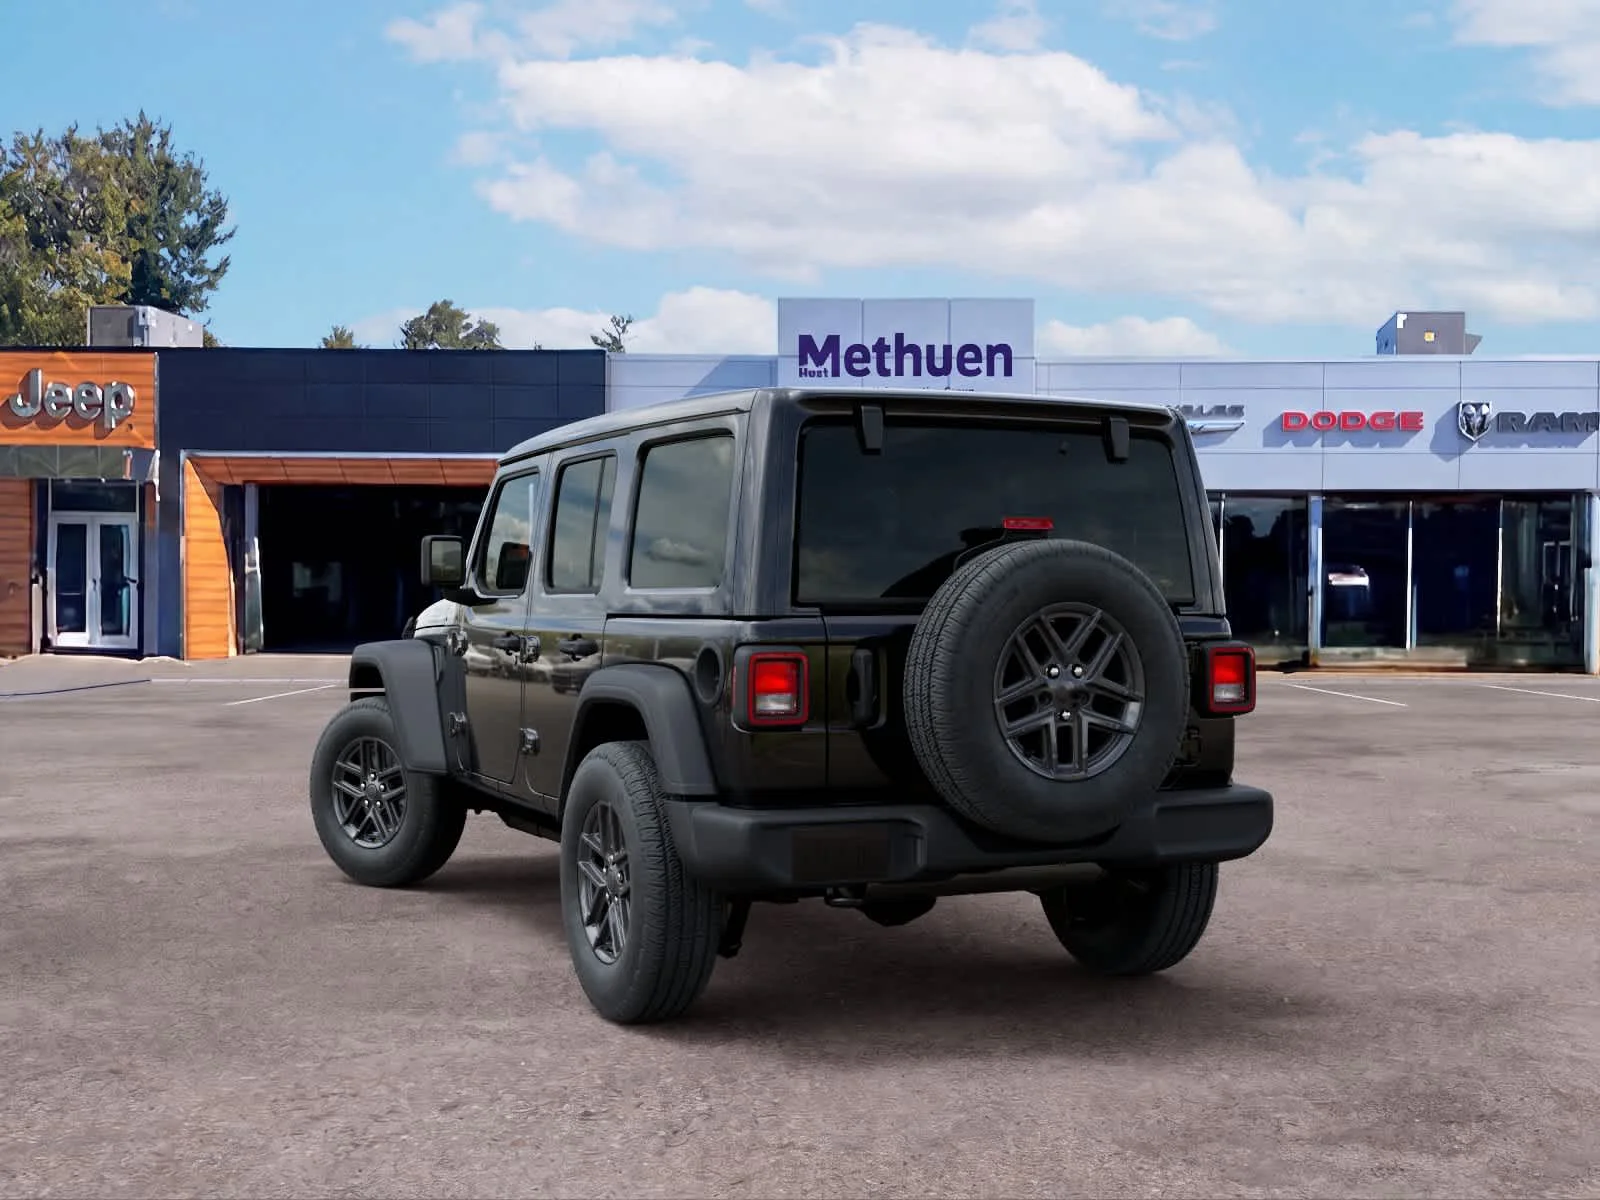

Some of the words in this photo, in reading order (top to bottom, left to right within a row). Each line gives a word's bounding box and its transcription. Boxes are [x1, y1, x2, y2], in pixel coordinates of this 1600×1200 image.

[798, 333, 1013, 378] Methuen
[9, 368, 136, 430] Jeep
[1282, 411, 1424, 432] DODGE
[1497, 411, 1599, 434] RAM
